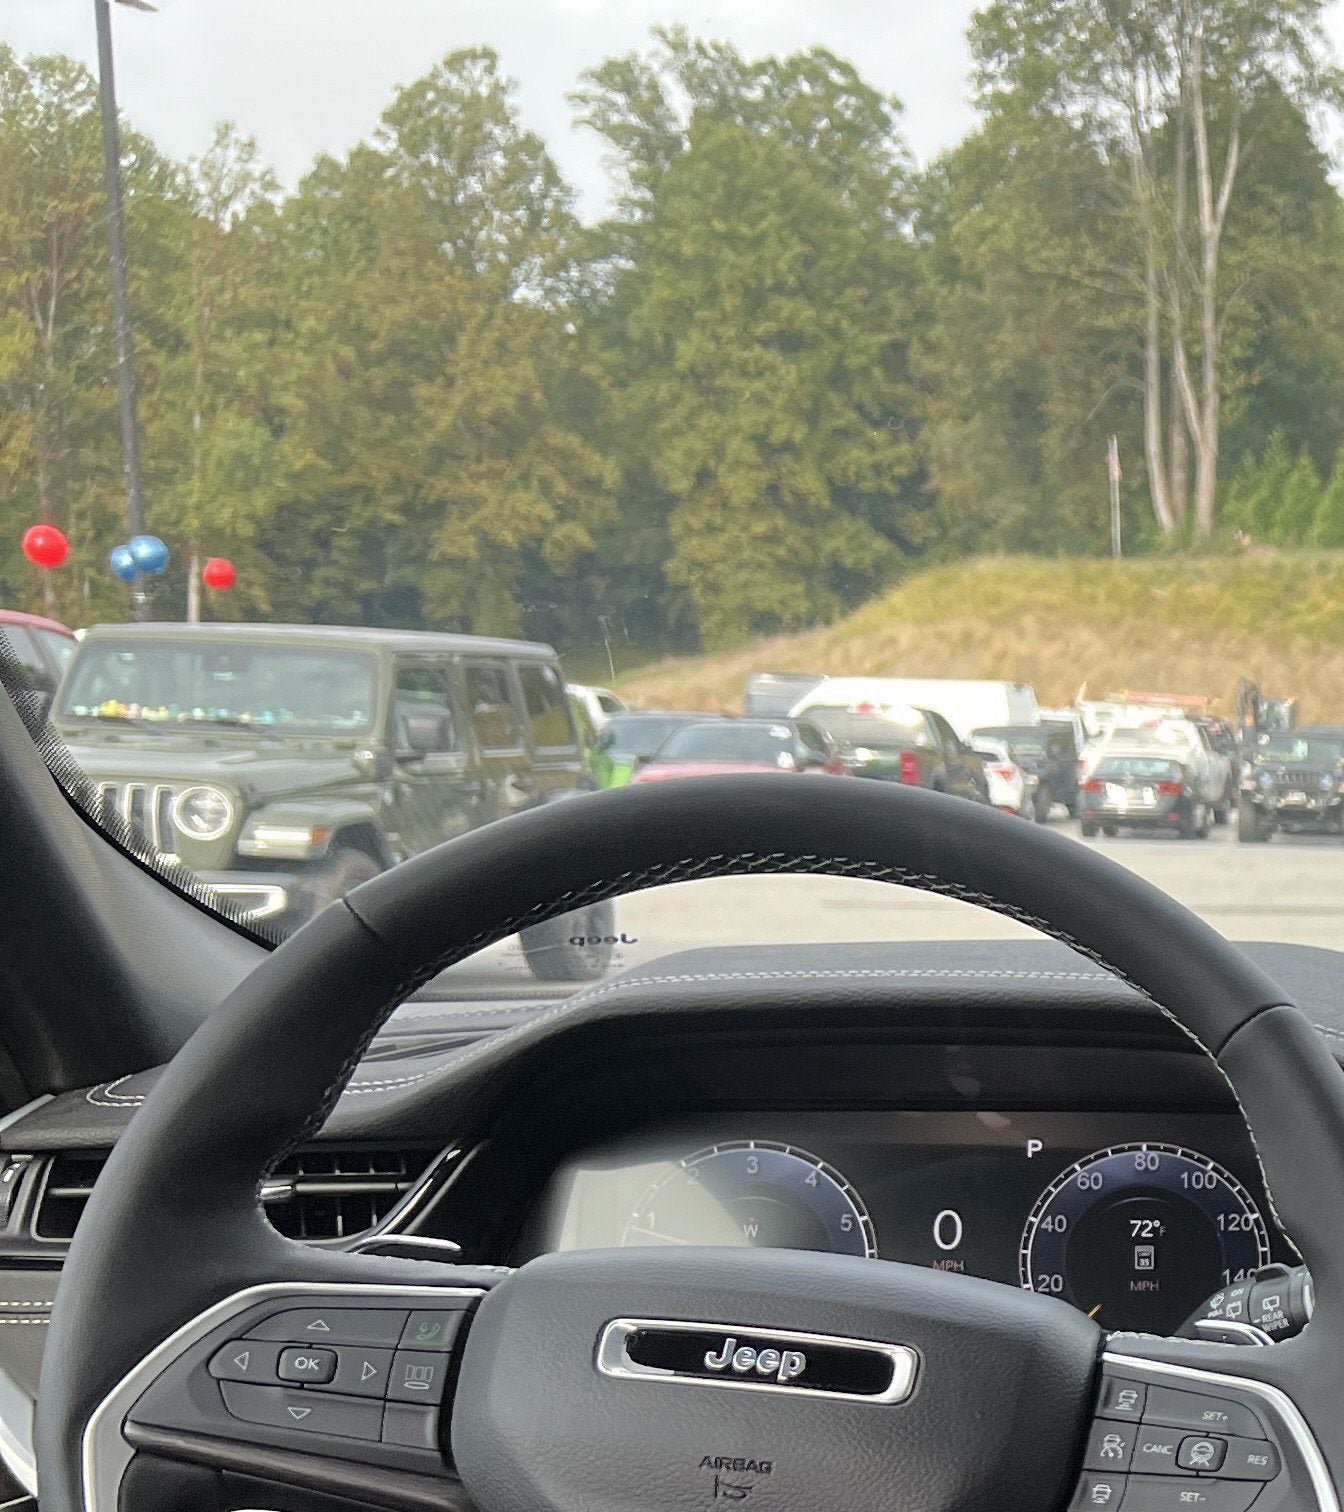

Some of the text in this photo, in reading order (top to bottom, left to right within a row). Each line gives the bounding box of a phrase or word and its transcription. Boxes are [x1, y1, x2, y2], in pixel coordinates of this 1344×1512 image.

[1027, 1140, 1042, 1158] P
[746, 1156, 759, 1174] 3
[1134, 1154, 1159, 1171] 80
[687, 1168, 700, 1186] 2
[804, 1170, 818, 1188] 4
[1077, 1172, 1103, 1190] 60
[1180, 1172, 1217, 1190] 100
[648, 1211, 656, 1229] 1
[840, 1214, 853, 1231] 5
[1041, 1215, 1067, 1232] 40
[1216, 1213, 1254, 1231] 120
[743, 1224, 758, 1237] W
[934, 1210, 962, 1250] 0
[933, 1260, 964, 1271] MPH
[1037, 1274, 1063, 1293] 20
[1130, 1281, 1159, 1291] MPH
[294, 1357, 320, 1370] OK
[704, 1338, 806, 1383] Jeep
[1203, 1410, 1229, 1422] SET+
[1143, 1443, 1175, 1455] CANC
[700, 1455, 773, 1475] AIRBAG
[1247, 1454, 1269, 1466] RES
